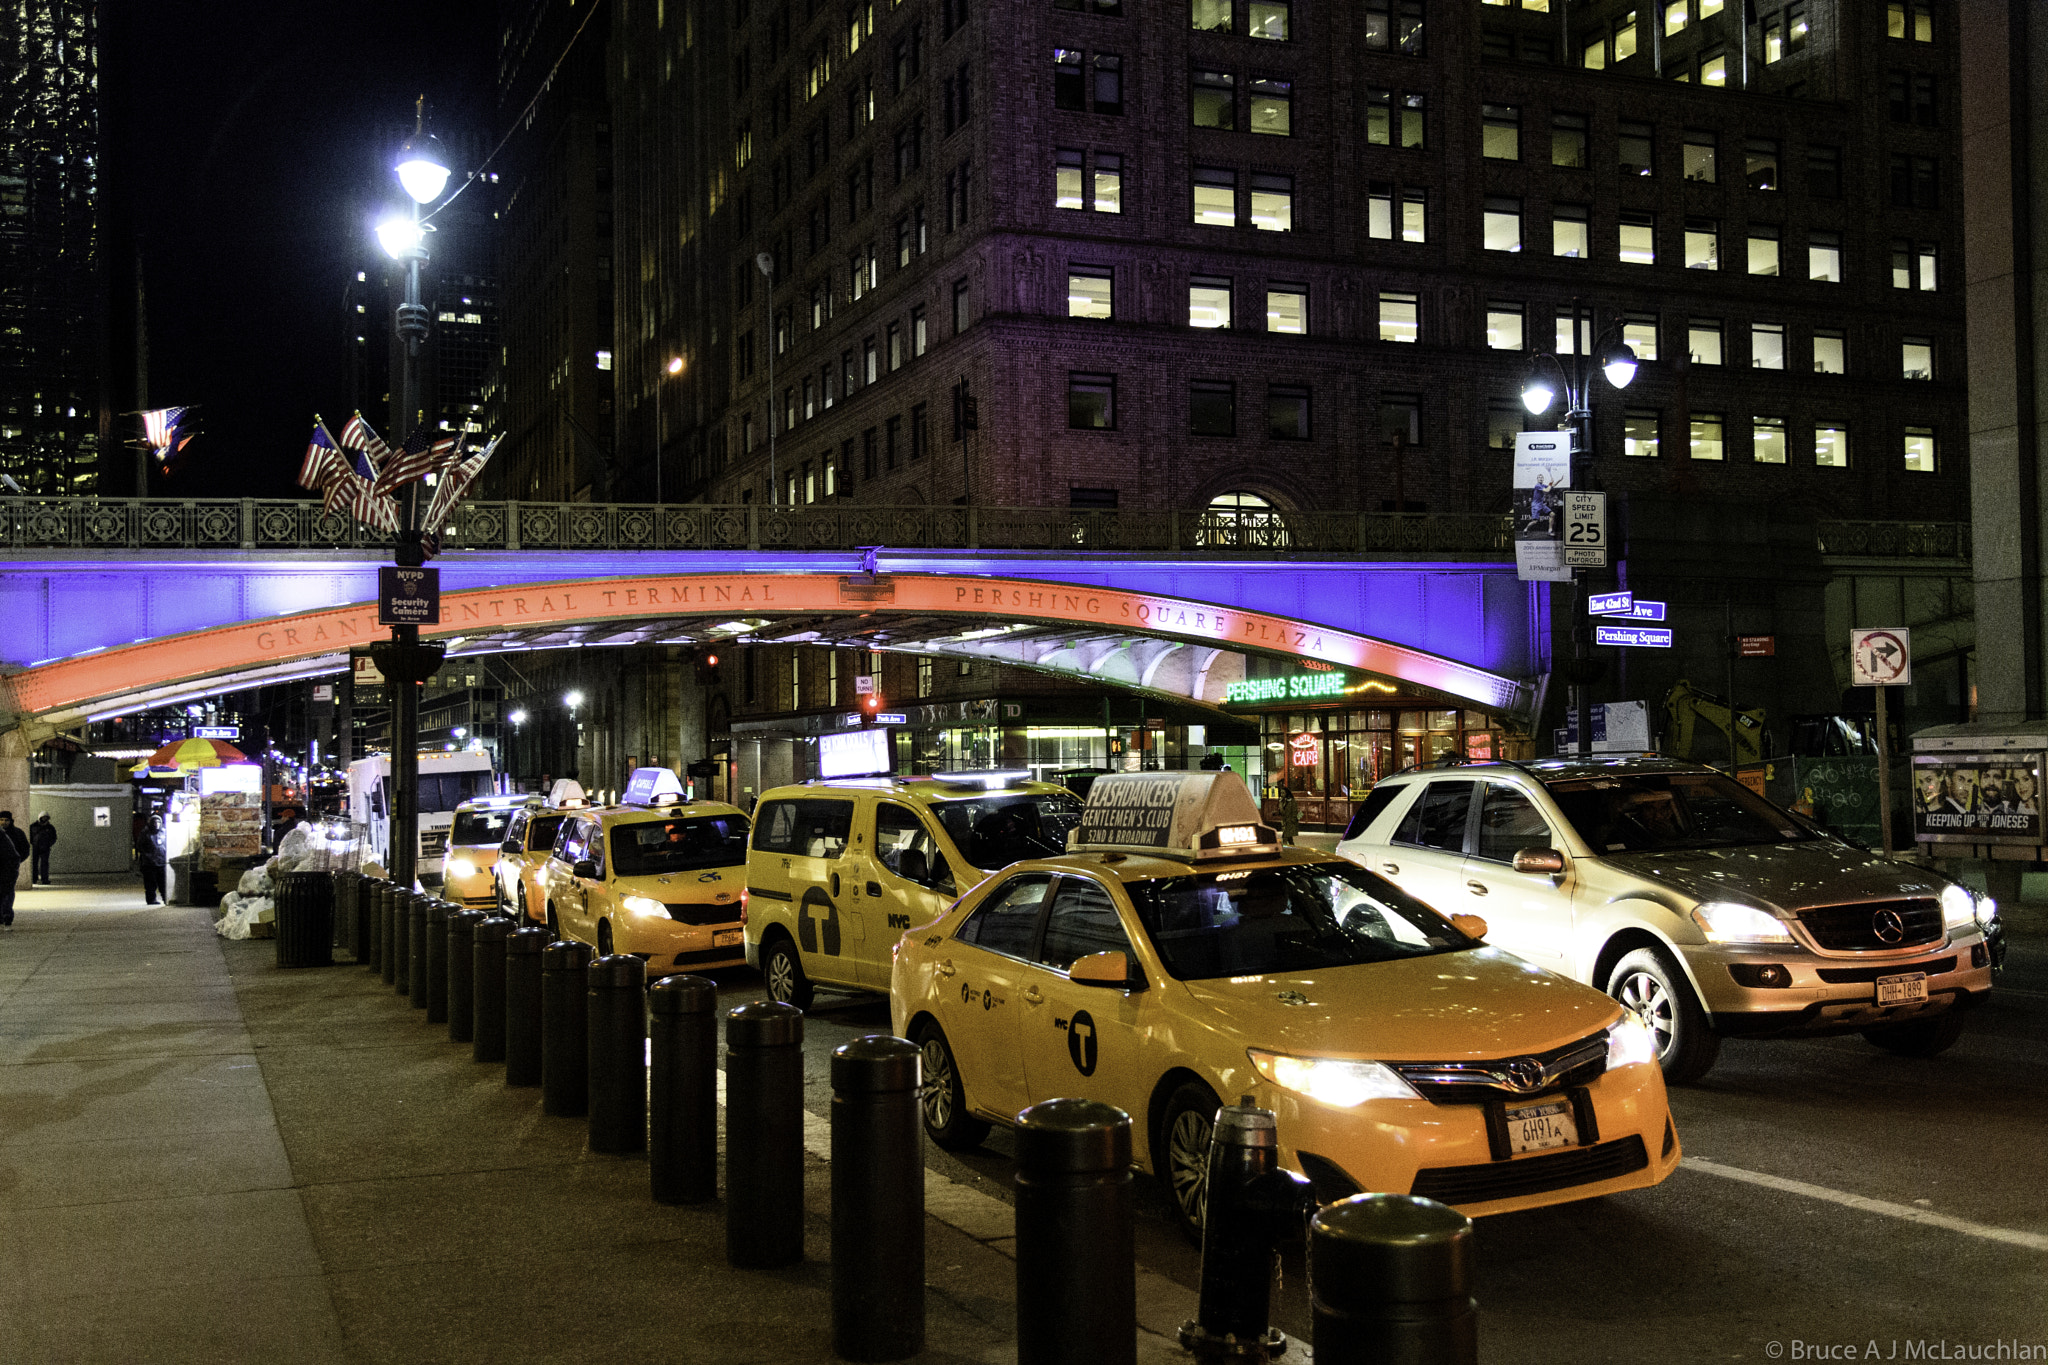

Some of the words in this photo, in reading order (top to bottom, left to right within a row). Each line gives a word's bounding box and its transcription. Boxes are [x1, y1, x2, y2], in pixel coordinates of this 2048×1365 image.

[1575, 495, 1593, 503] CITY
[1572, 504, 1596, 512] SPEED
[1569, 522, 1601, 543] 25
[396, 571, 424, 580] NYPD
[391, 597, 430, 609] Security
[602, 584, 775, 607] TERMINAL
[392, 606, 429, 616] Camera
[1590, 600, 1606, 611] East
[1605, 598, 1622, 610] 42nd
[1621, 596, 1630, 609] St
[1633, 605, 1653, 617] Ave
[257, 614, 387, 650] GRAND
[439, 593, 577, 624] ENTRAL
[955, 586, 1101, 615] PERSHING
[1120, 601, 1226, 632] SQUARE
[1243, 621, 1325, 652] PLAZA
[1598, 629, 1638, 645] Pershing
[1638, 631, 1670, 646] Square
[1226, 676, 1287, 702] PERSHING
[1289, 672, 1346, 698] SQUARE
[1004, 703, 1021, 717] TD
[1739, 715, 1754, 728] CAT
[831, 733, 847, 752] YORK
[1293, 750, 1319, 766] CAFE
[1086, 780, 1183, 808] FLASHDANCERS
[1082, 809, 1144, 827] GENTLEMEN'S
[1146, 810, 1171, 828] CLUB
[1925, 813, 1963, 827] KEEPING
[1963, 814, 1976, 828] UP
[1990, 815, 2029, 829] JONESES
[1088, 830, 1107, 843] 52ND
[1107, 831, 1114, 844] &
[1116, 830, 1157, 845] BROADWAY
[887, 913, 910, 929] NYC
[1054, 1017, 1068, 1030] NYC
[1519, 1107, 1537, 1119] NEW
[1539, 1104, 1560, 1116] YORK
